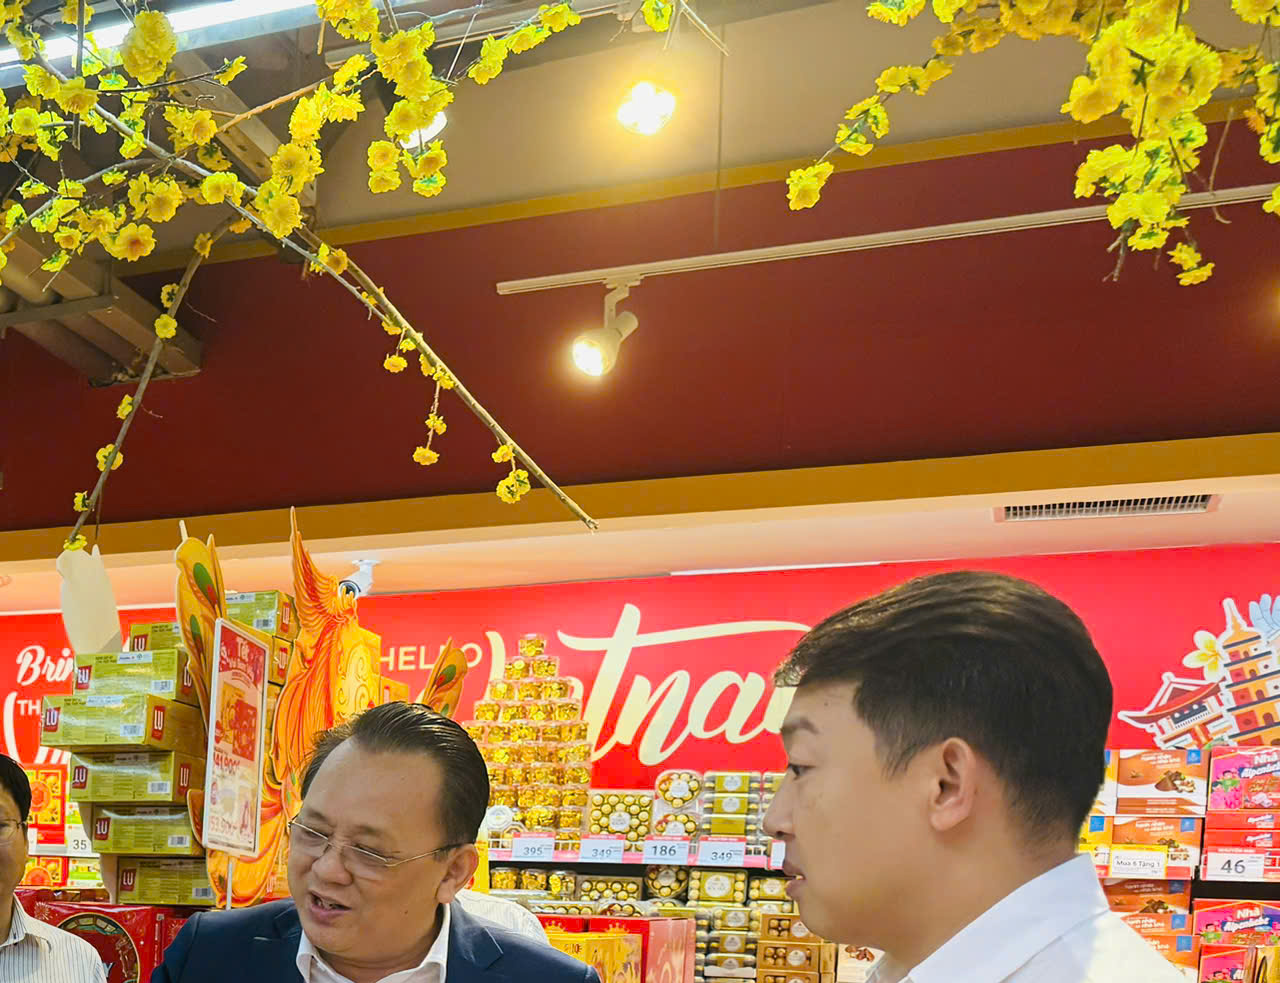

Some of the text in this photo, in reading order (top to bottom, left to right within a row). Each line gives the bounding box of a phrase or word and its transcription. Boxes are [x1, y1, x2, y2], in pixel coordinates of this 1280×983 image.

[17, 699, 41, 716] TH
[73, 839, 87, 850] 35
[523, 847, 544, 856] 395
[591, 848, 613, 858] 349
[652, 845, 677, 857] 186
[711, 852, 733, 862] 349
[1220, 859, 1246, 874] 46
